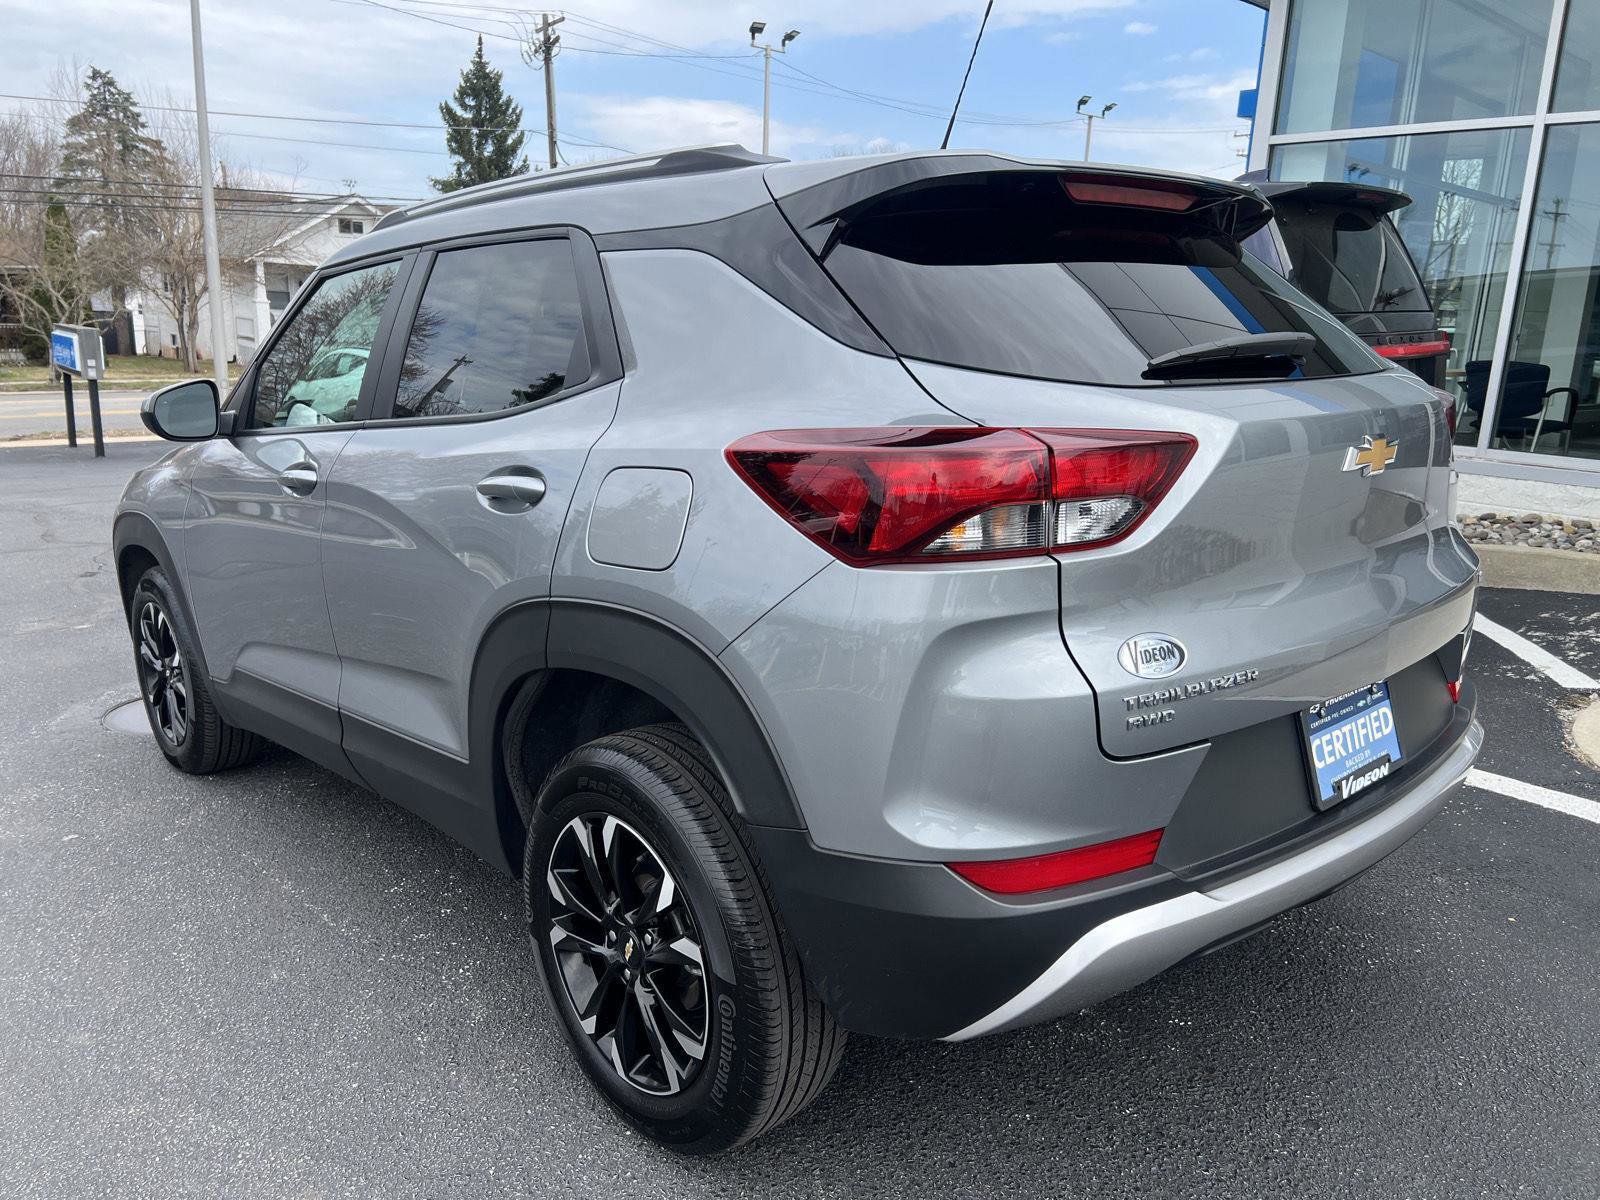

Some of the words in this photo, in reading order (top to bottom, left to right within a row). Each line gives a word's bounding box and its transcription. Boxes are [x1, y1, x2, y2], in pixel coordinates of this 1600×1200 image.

[1126, 640, 1177, 674] VIDEON
[1122, 668, 1259, 711] TRAILBLAZER
[1311, 706, 1393, 769] CERTIFIED
[1341, 763, 1389, 799] VIDEON
[711, 993, 737, 1109] Continental
